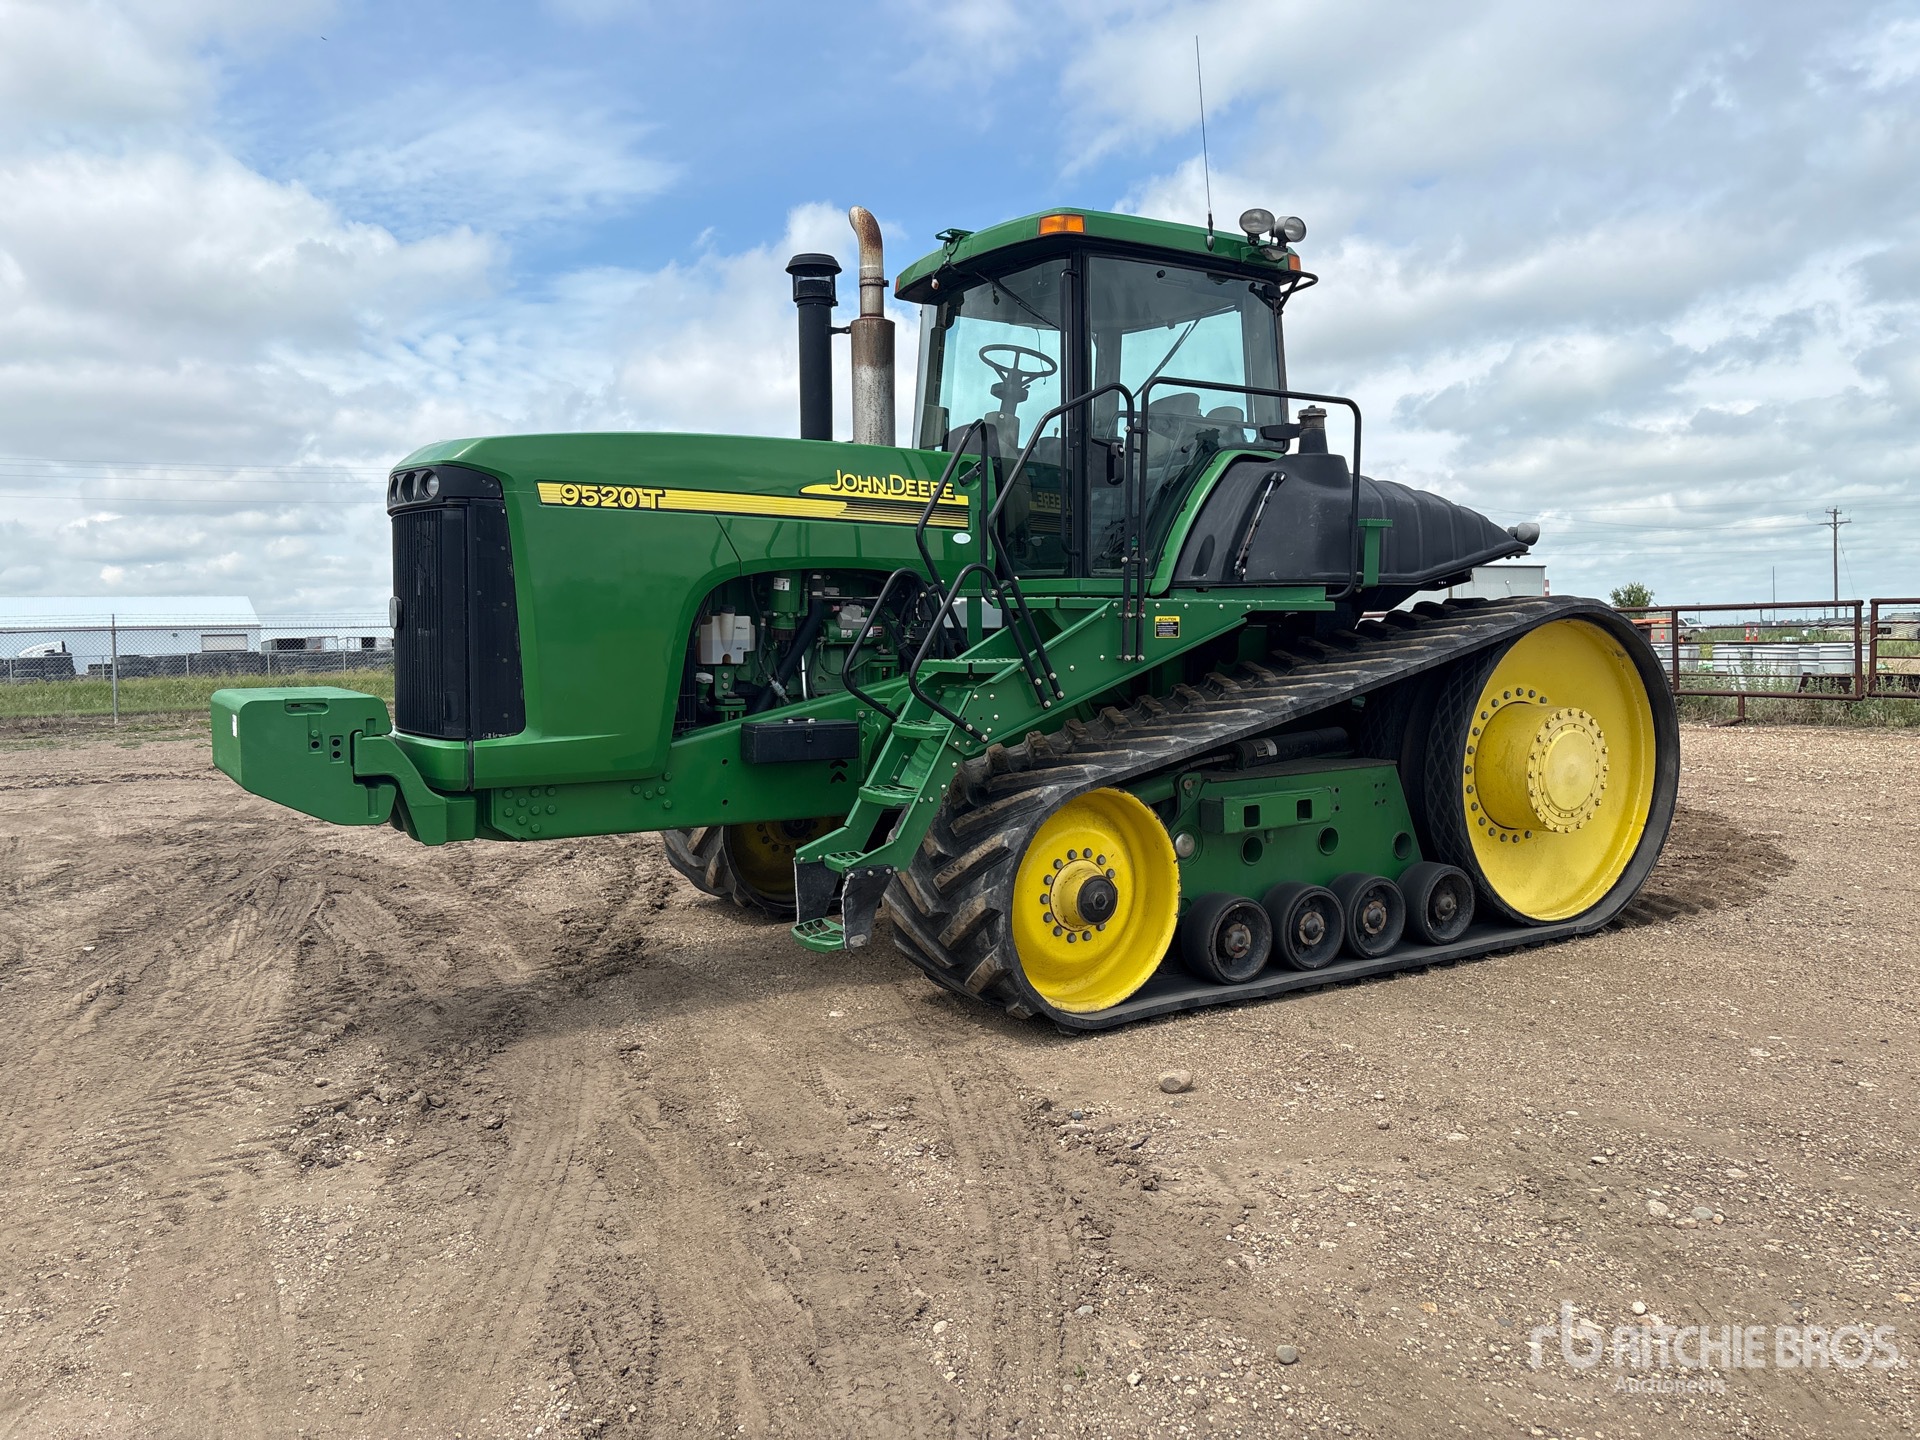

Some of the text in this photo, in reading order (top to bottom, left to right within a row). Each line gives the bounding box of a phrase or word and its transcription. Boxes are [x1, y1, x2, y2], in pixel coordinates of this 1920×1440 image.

[560, 484, 666, 510] 9520T
[830, 469, 957, 500] JOHN DEERE
